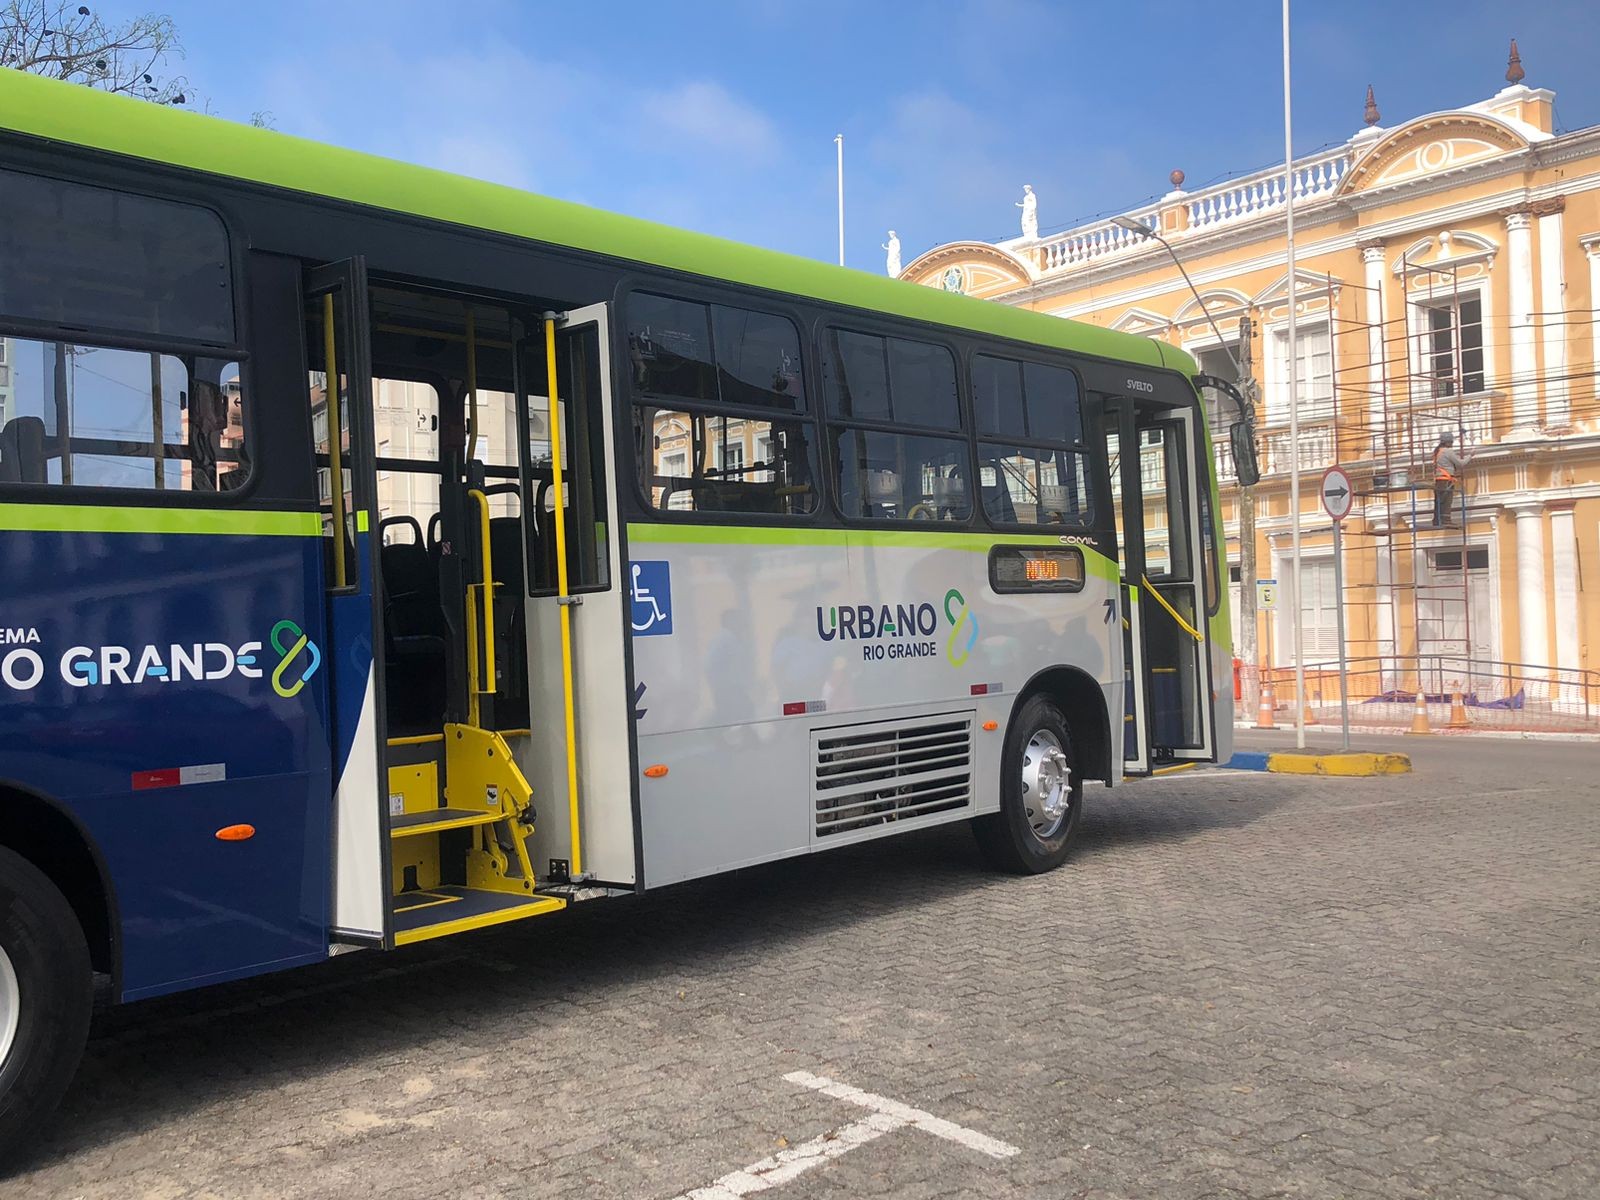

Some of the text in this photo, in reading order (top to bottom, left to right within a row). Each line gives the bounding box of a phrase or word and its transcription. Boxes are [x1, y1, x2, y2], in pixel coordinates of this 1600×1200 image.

[1126, 379, 1154, 393] SVELTO
[1058, 535, 1099, 546] COMIL
[1025, 560, 1058, 579] NOVO
[816, 602, 937, 642] URBANO
[863, 642, 937, 661] RIO GRANDE
[60, 641, 263, 687] GRANDE
